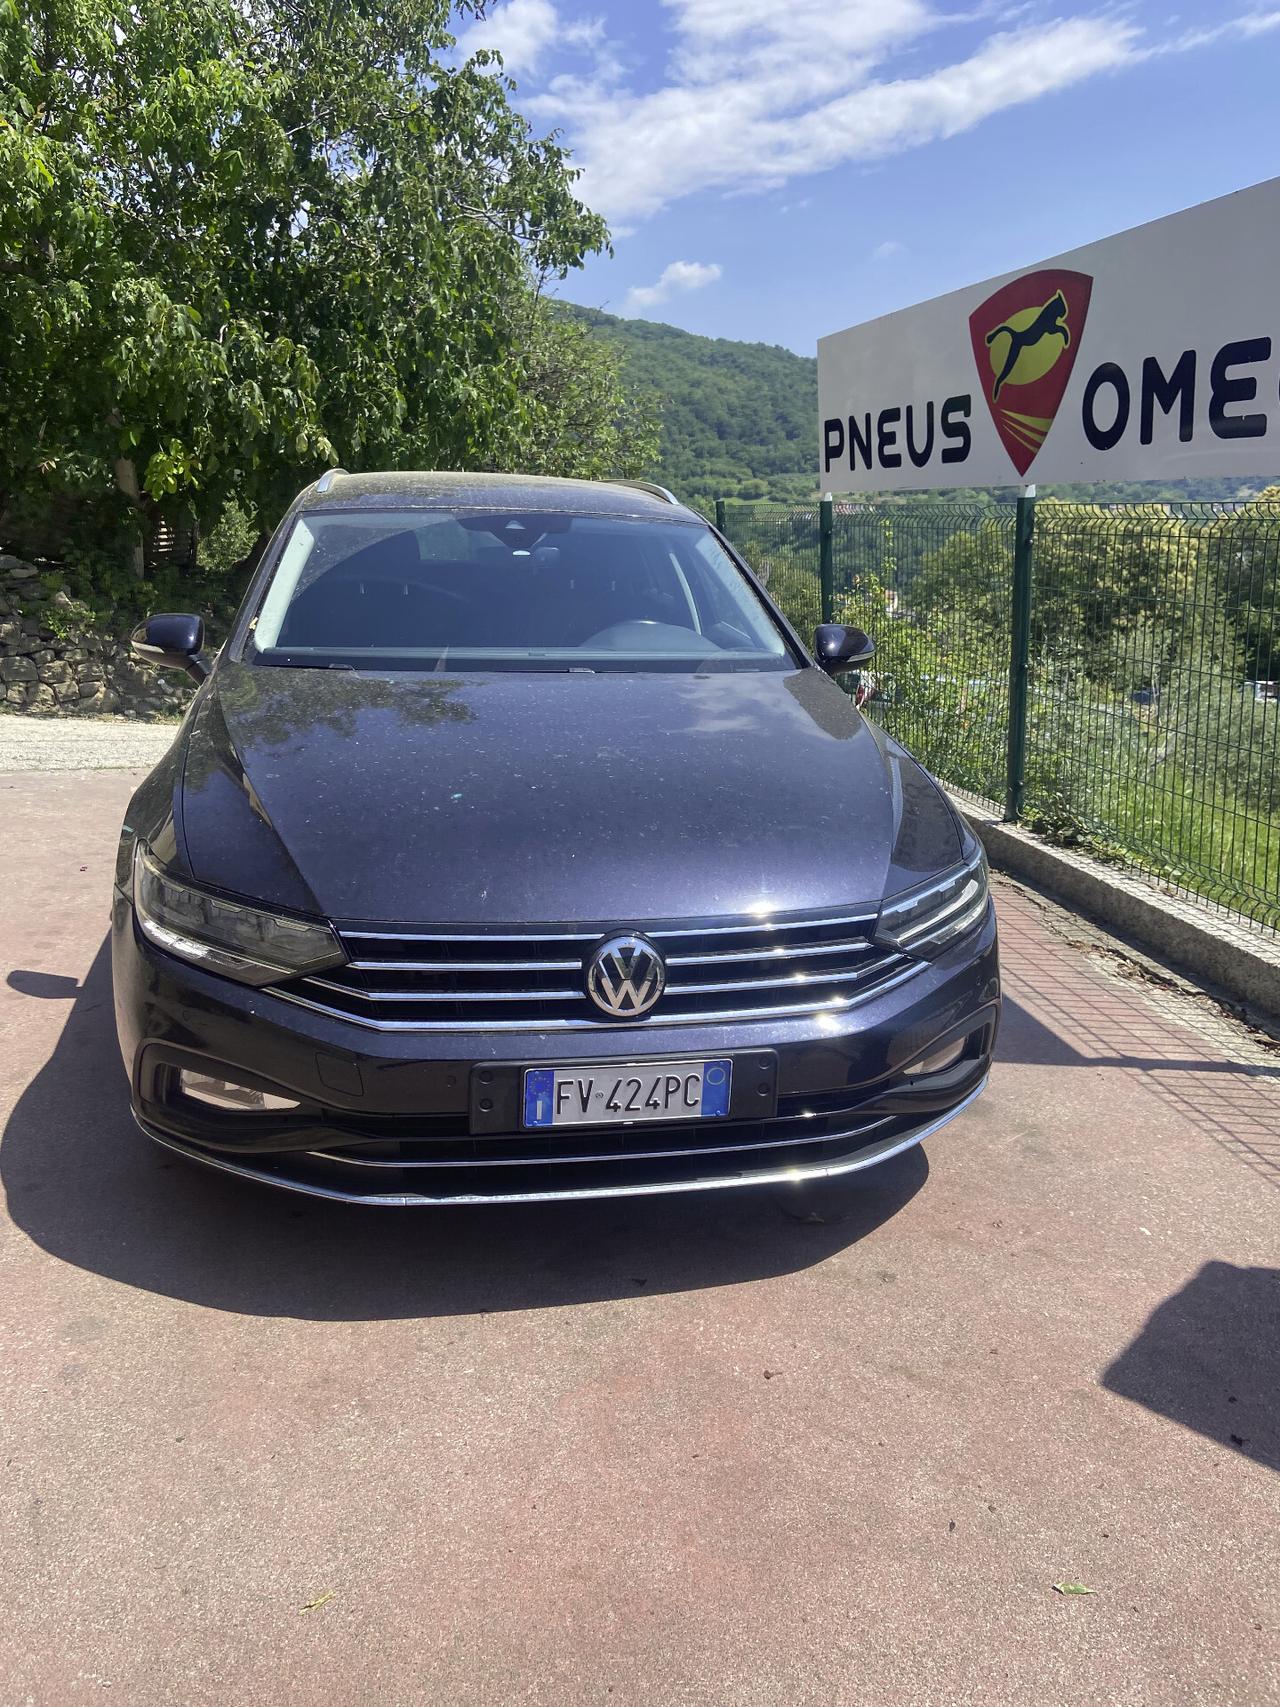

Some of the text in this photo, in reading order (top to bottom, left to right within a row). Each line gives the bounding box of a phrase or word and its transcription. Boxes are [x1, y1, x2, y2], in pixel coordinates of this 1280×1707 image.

[824, 336, 1280, 473] PNEUS OME
[593, 938, 661, 1014] VW
[556, 1074, 700, 1114] FV 424PC
